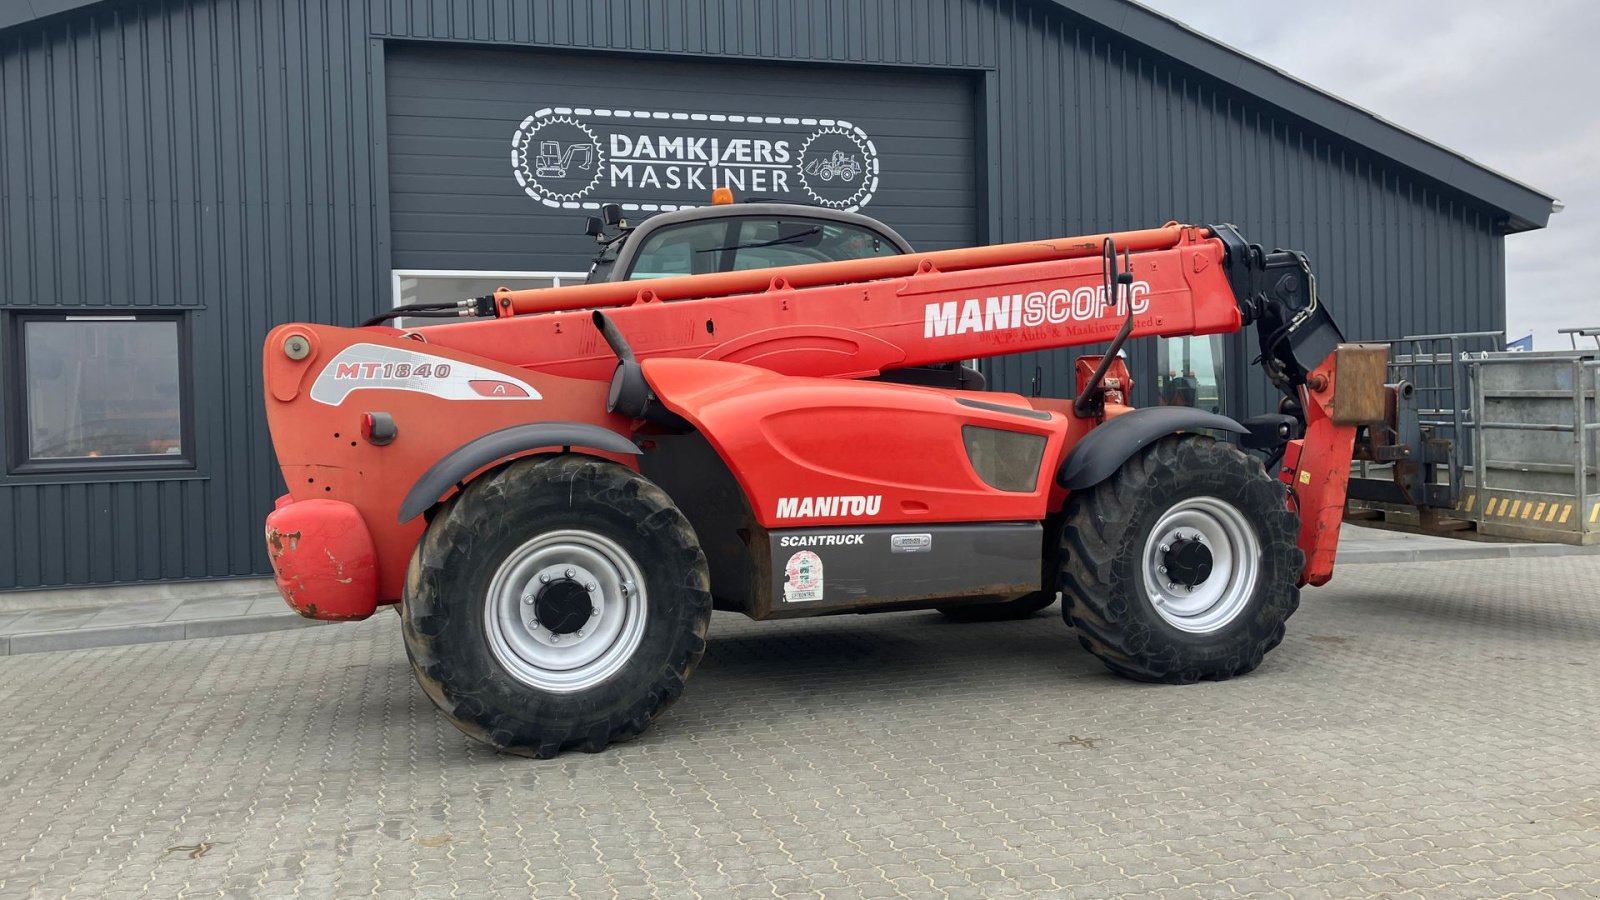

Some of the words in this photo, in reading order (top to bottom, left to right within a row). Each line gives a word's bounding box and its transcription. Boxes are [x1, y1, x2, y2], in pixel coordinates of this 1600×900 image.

[610, 133, 790, 167] DAMKJÆRS
[611, 164, 791, 193] MASKINER
[923, 281, 1150, 339] MANISCOPIC
[335, 362, 452, 380] MT1840
[776, 495, 882, 519] MANITOU
[780, 534, 865, 547] SCANTRUCK
